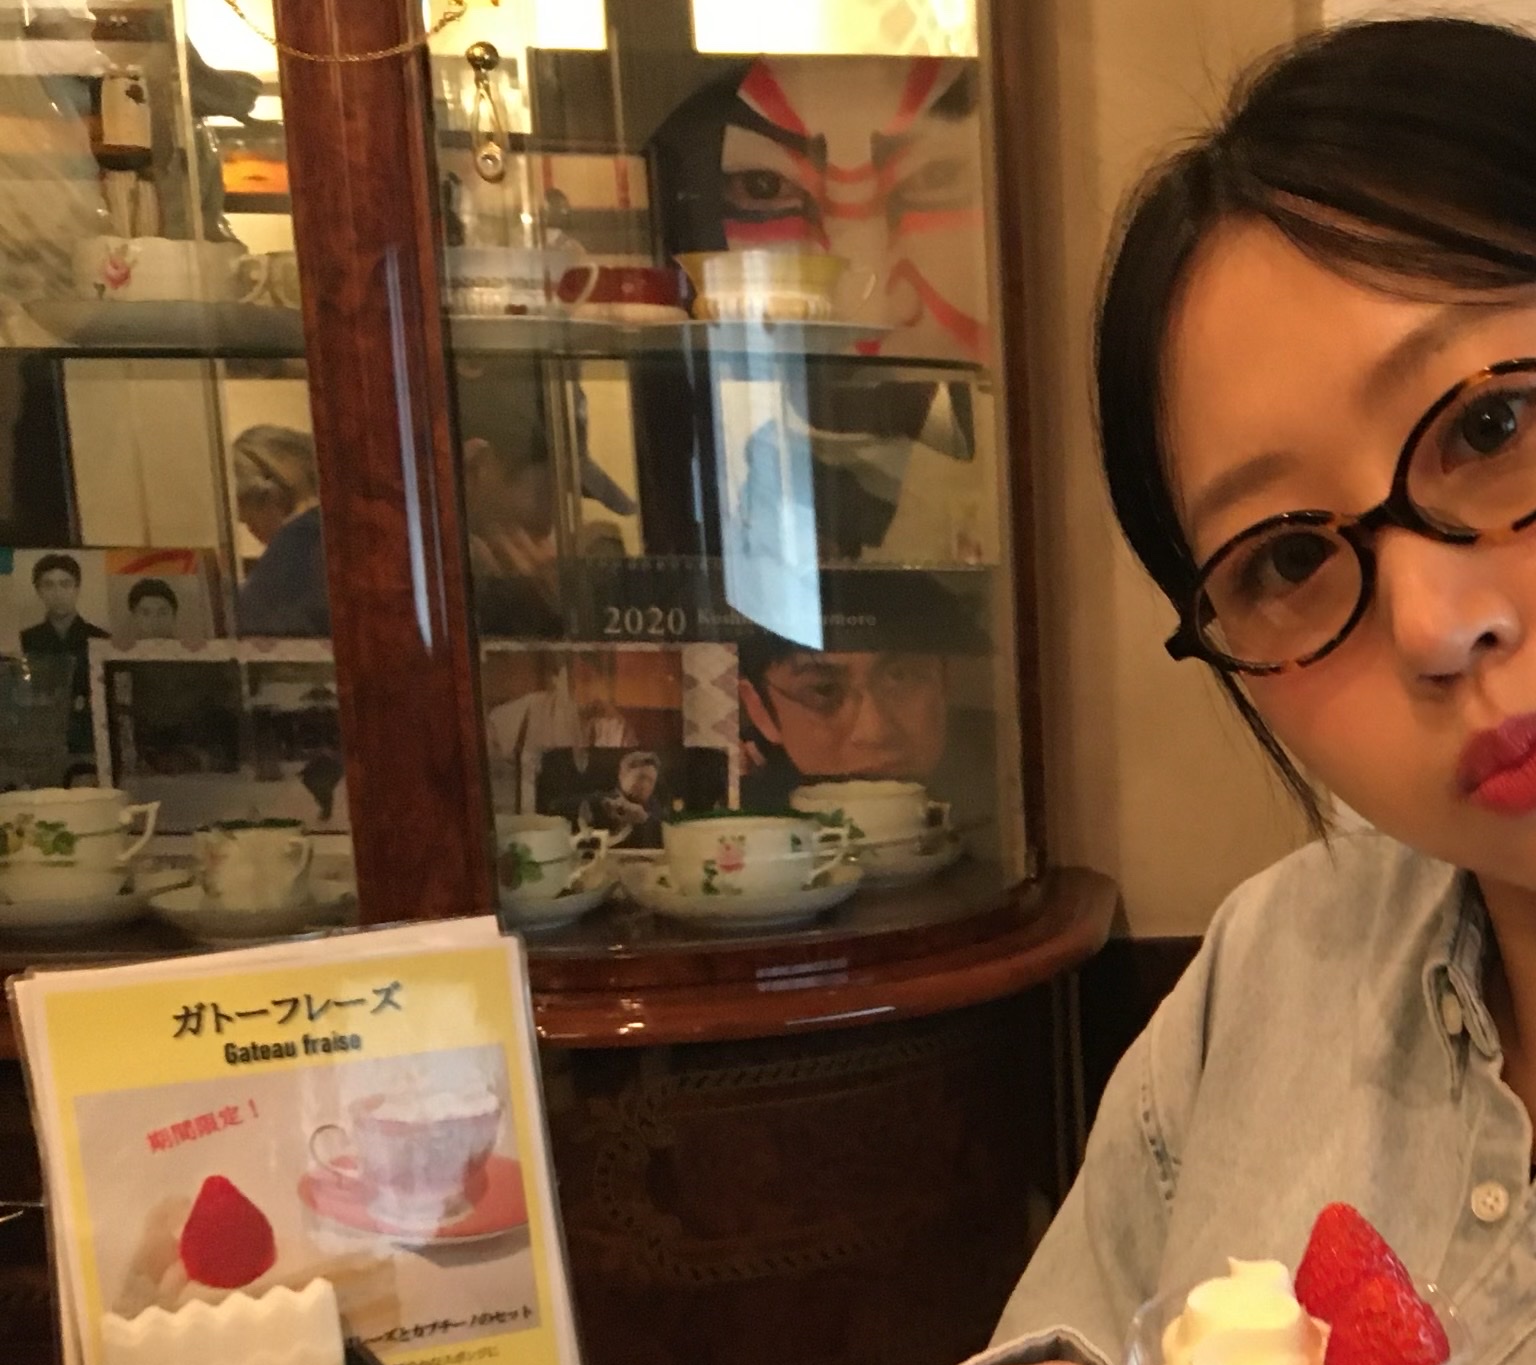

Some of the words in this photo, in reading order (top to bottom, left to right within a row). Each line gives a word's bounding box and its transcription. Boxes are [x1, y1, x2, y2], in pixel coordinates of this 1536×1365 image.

[604, 606, 687, 635] 2020
[173, 980, 404, 1038] ガトーフレーズ
[224, 1040, 298, 1066] Gateau
[303, 1031, 362, 1056] fraise
